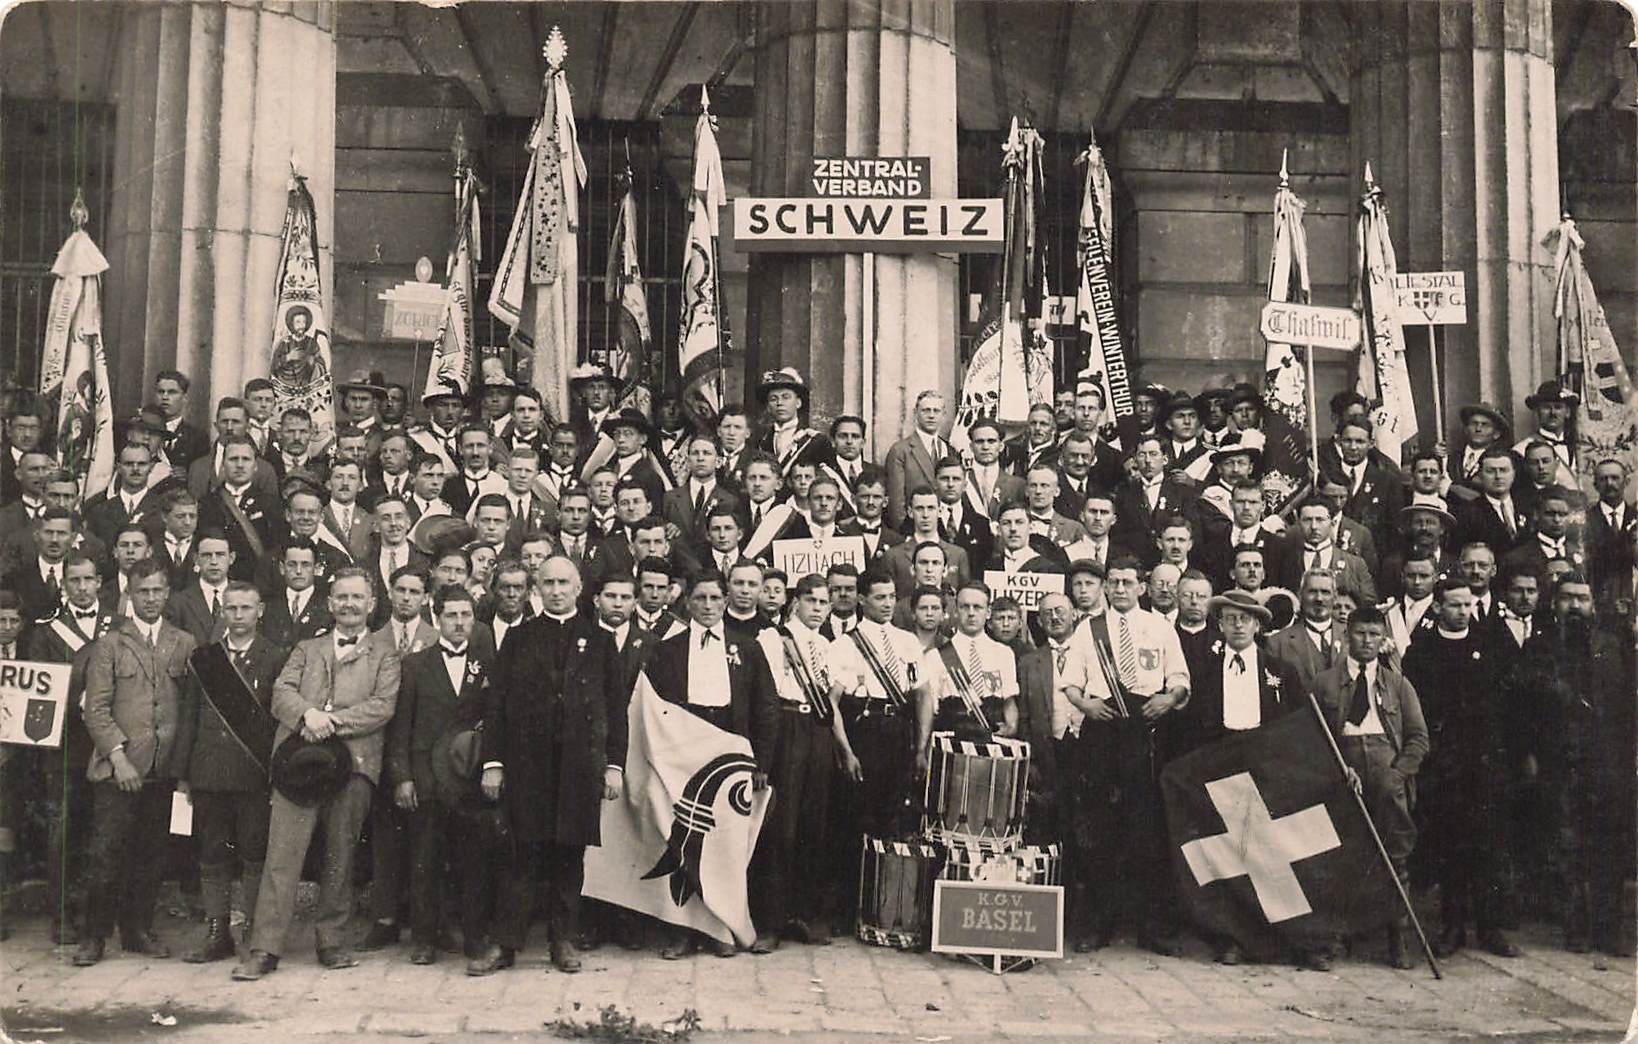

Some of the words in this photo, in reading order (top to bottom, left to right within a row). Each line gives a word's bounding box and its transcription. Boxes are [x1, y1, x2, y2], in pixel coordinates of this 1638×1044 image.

[813, 159, 922, 178] ZENTRAL-
[812, 179, 922, 197] VERBAND
[749, 203, 989, 236] SCHWEIZ
[961, 907, 1037, 933] BASEL
